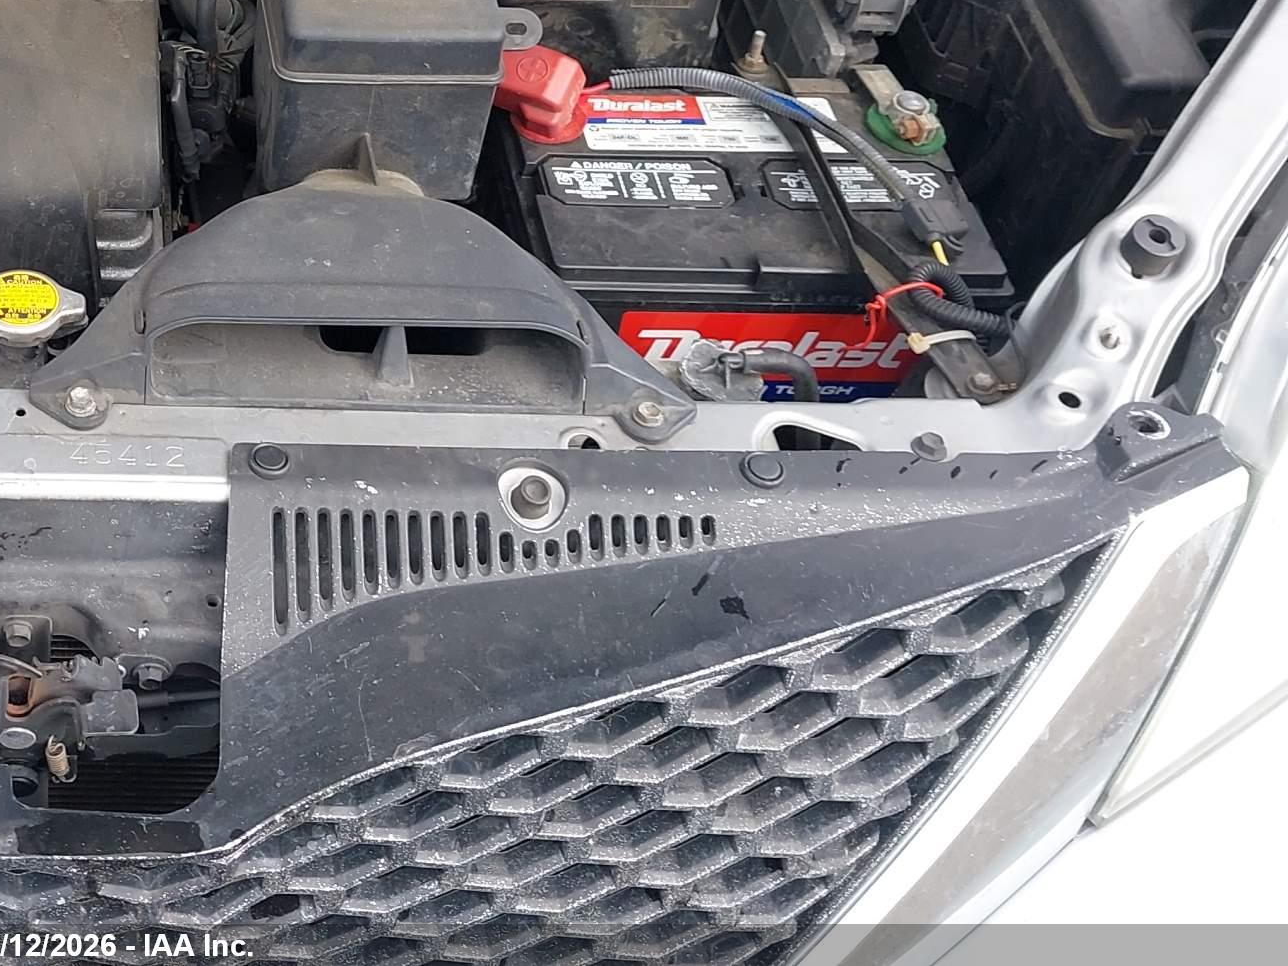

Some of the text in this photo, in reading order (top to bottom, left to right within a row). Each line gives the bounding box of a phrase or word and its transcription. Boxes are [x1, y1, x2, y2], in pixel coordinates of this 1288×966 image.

[587, 98, 687, 112] Duralast
[582, 160, 633, 171] DANGER
[644, 162, 692, 172] POISON
[7, 307, 47, 315] ATTENTION
